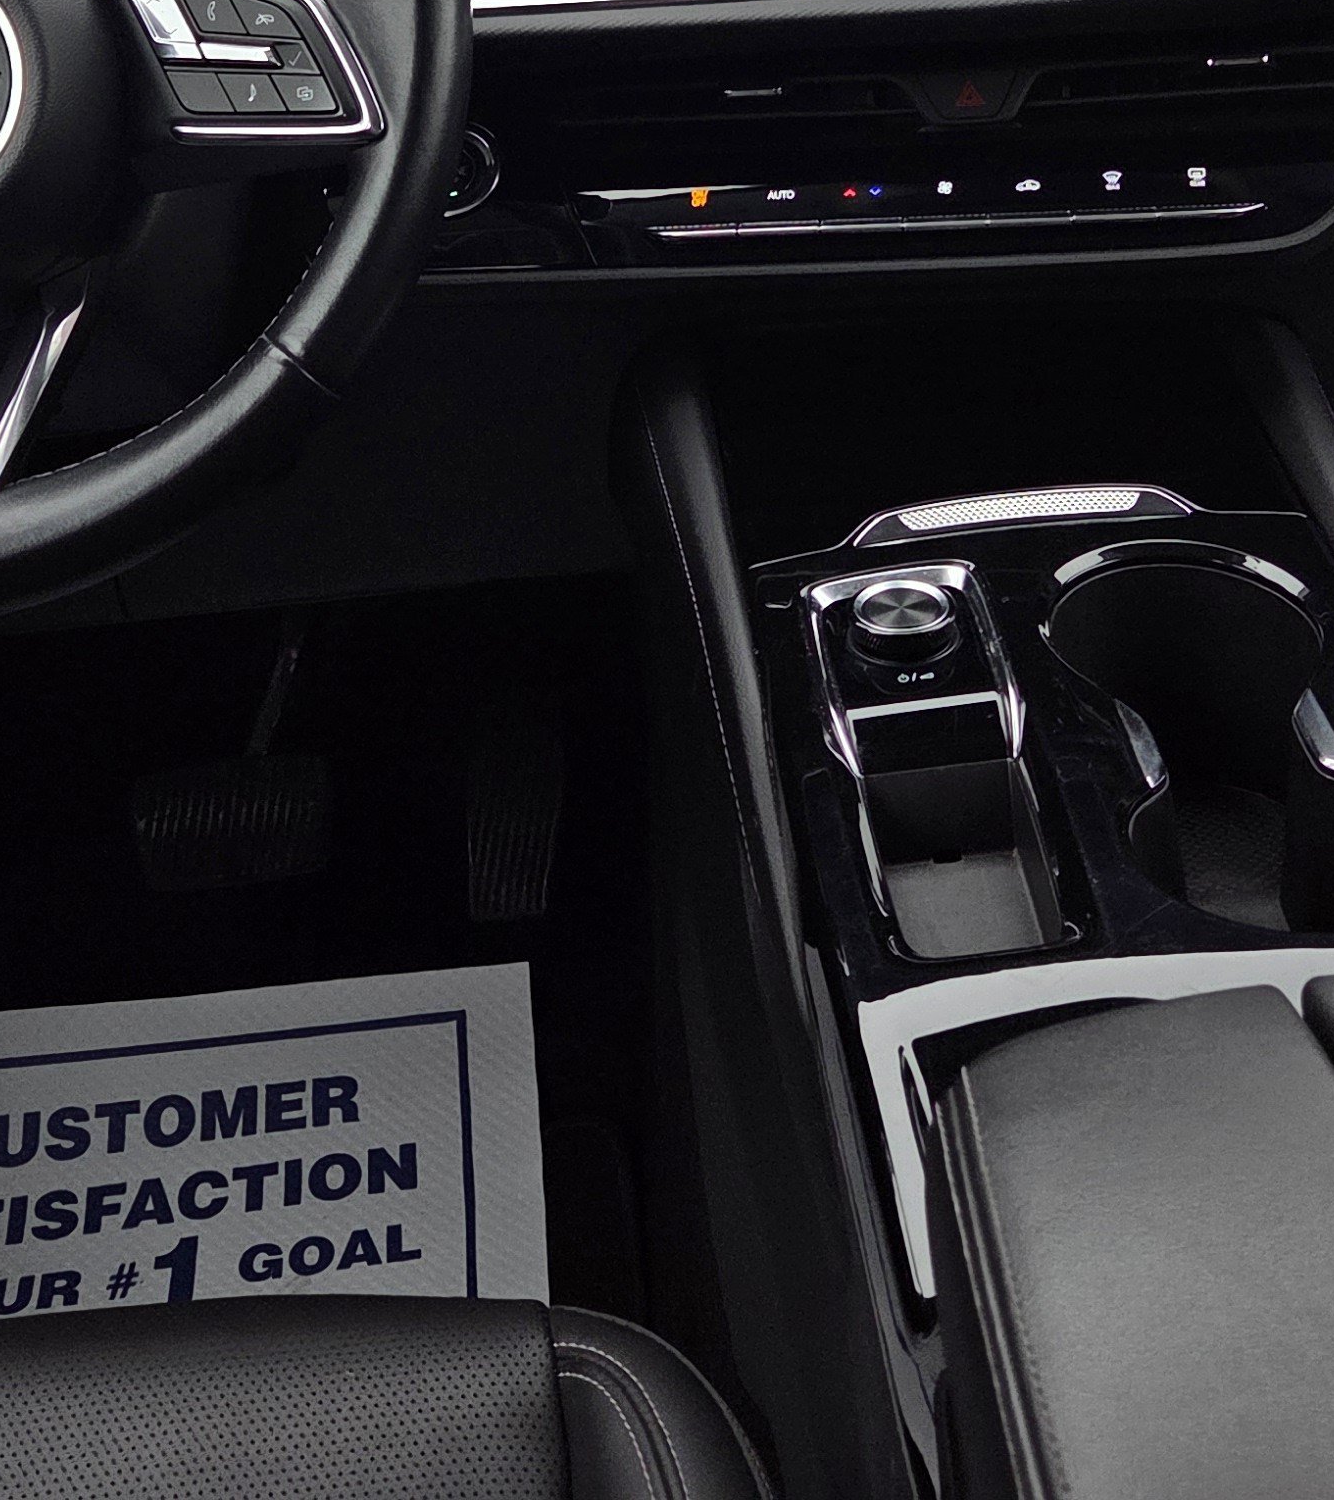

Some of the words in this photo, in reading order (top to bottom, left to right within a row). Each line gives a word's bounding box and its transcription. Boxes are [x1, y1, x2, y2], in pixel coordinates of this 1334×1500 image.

[767, 189, 796, 200] AUTO
[105, 1235, 200, 1303] #1
[237, 1224, 423, 1283] GOAL
